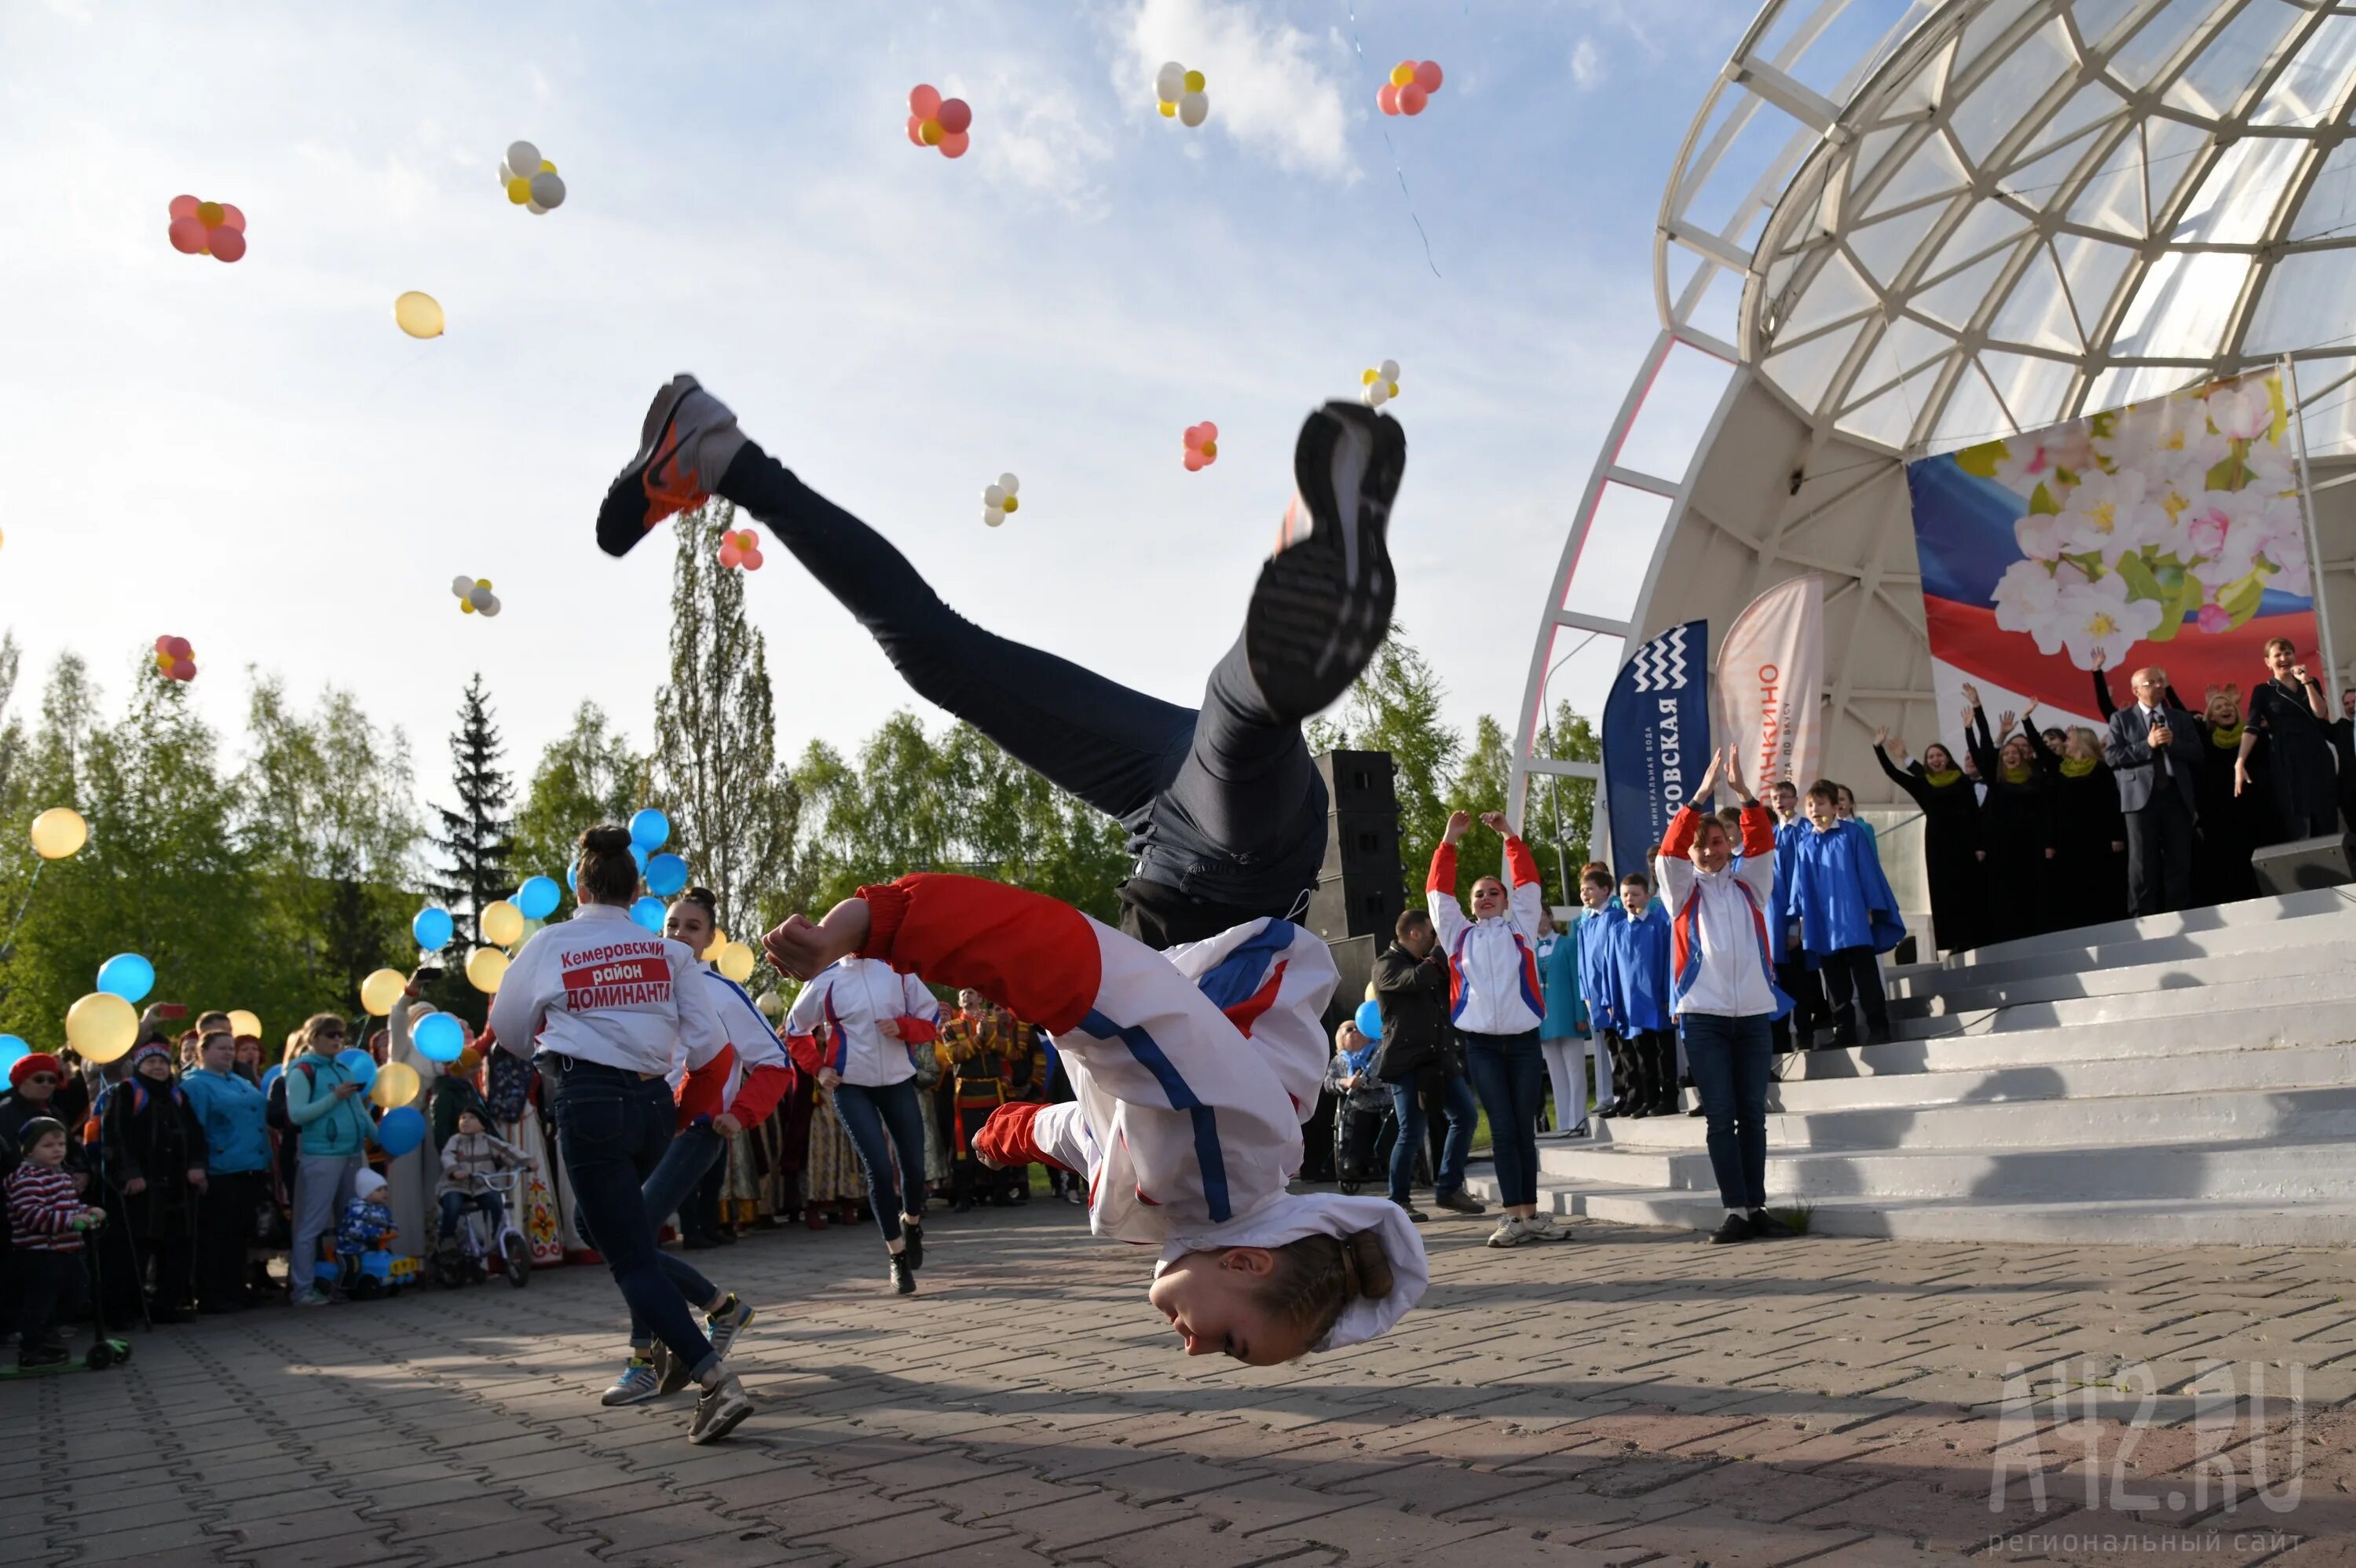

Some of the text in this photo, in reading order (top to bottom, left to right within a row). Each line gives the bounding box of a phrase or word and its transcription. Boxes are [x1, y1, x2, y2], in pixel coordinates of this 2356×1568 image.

[1644, 726, 1653, 751] ВОДА
[1783, 703, 1792, 783] ОДА ПО ВКУСУ
[1659, 697, 1684, 825] СОВСКАЯ
[1647, 757, 1659, 826] МИНЕРАЛЬНАЯ
[561, 941, 664, 968] Кемеровский
[592, 963, 643, 985] район
[566, 982, 670, 1012] ДОМИНАНТА
